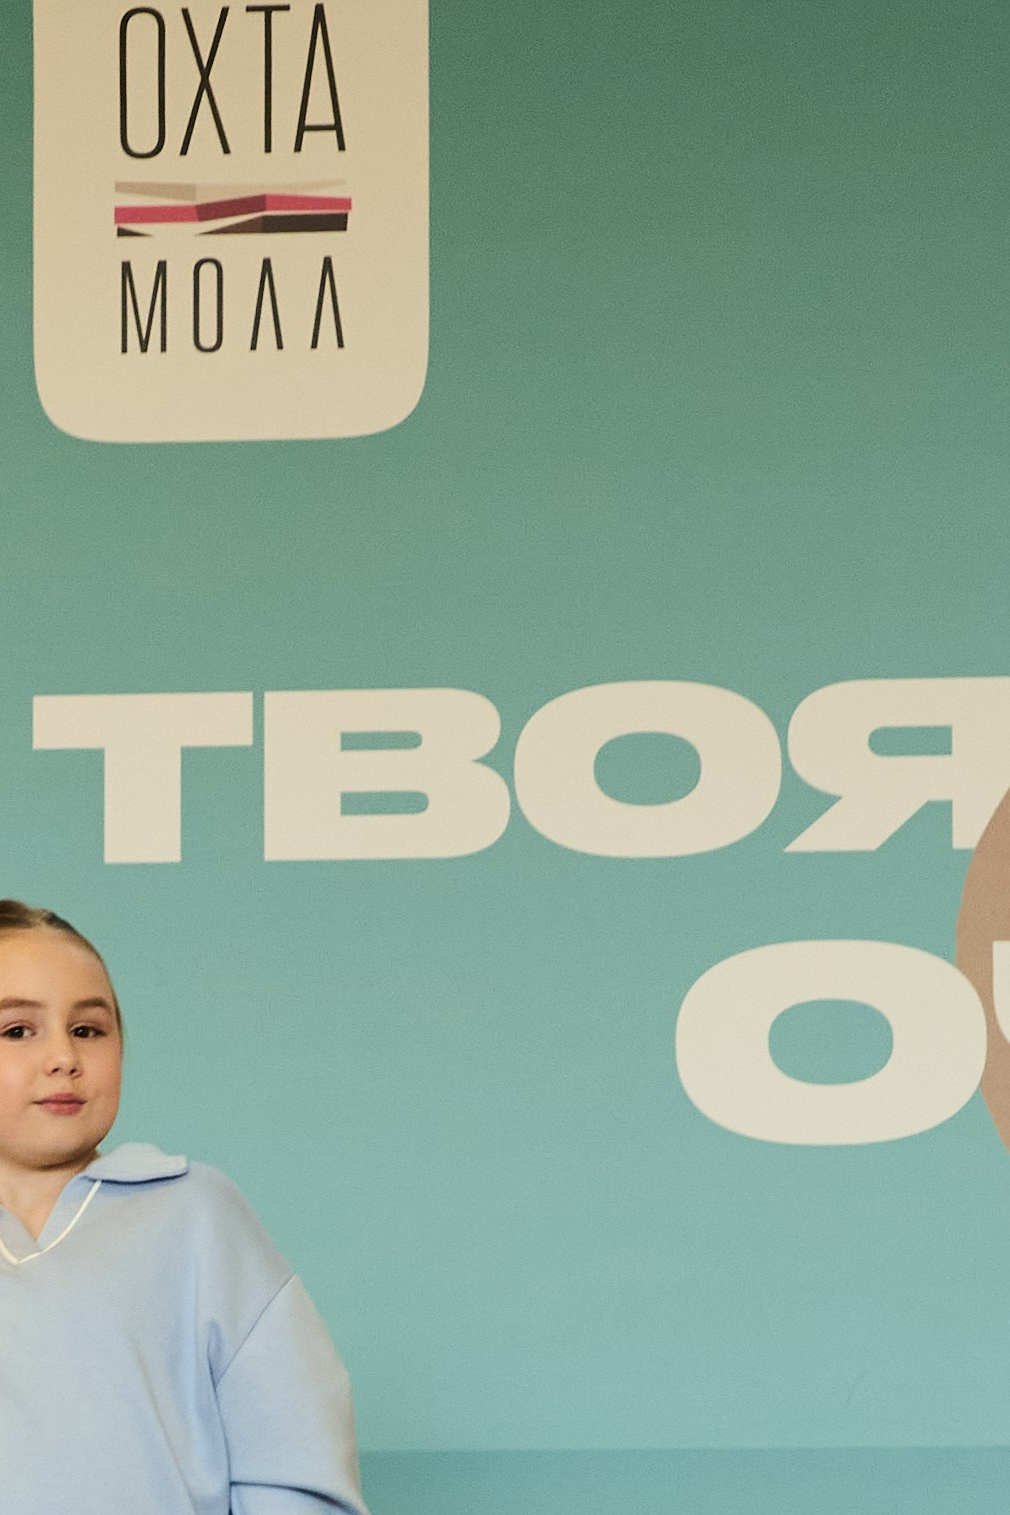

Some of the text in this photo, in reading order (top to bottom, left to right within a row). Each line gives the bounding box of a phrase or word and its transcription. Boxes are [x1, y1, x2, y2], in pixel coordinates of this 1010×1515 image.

[118, 3, 347, 159] ОХТА
[120, 256, 345, 354] МОЛЛ
[32, 676, 1010, 864] ТВОЯ
[676, 939, 1010, 1146] О
